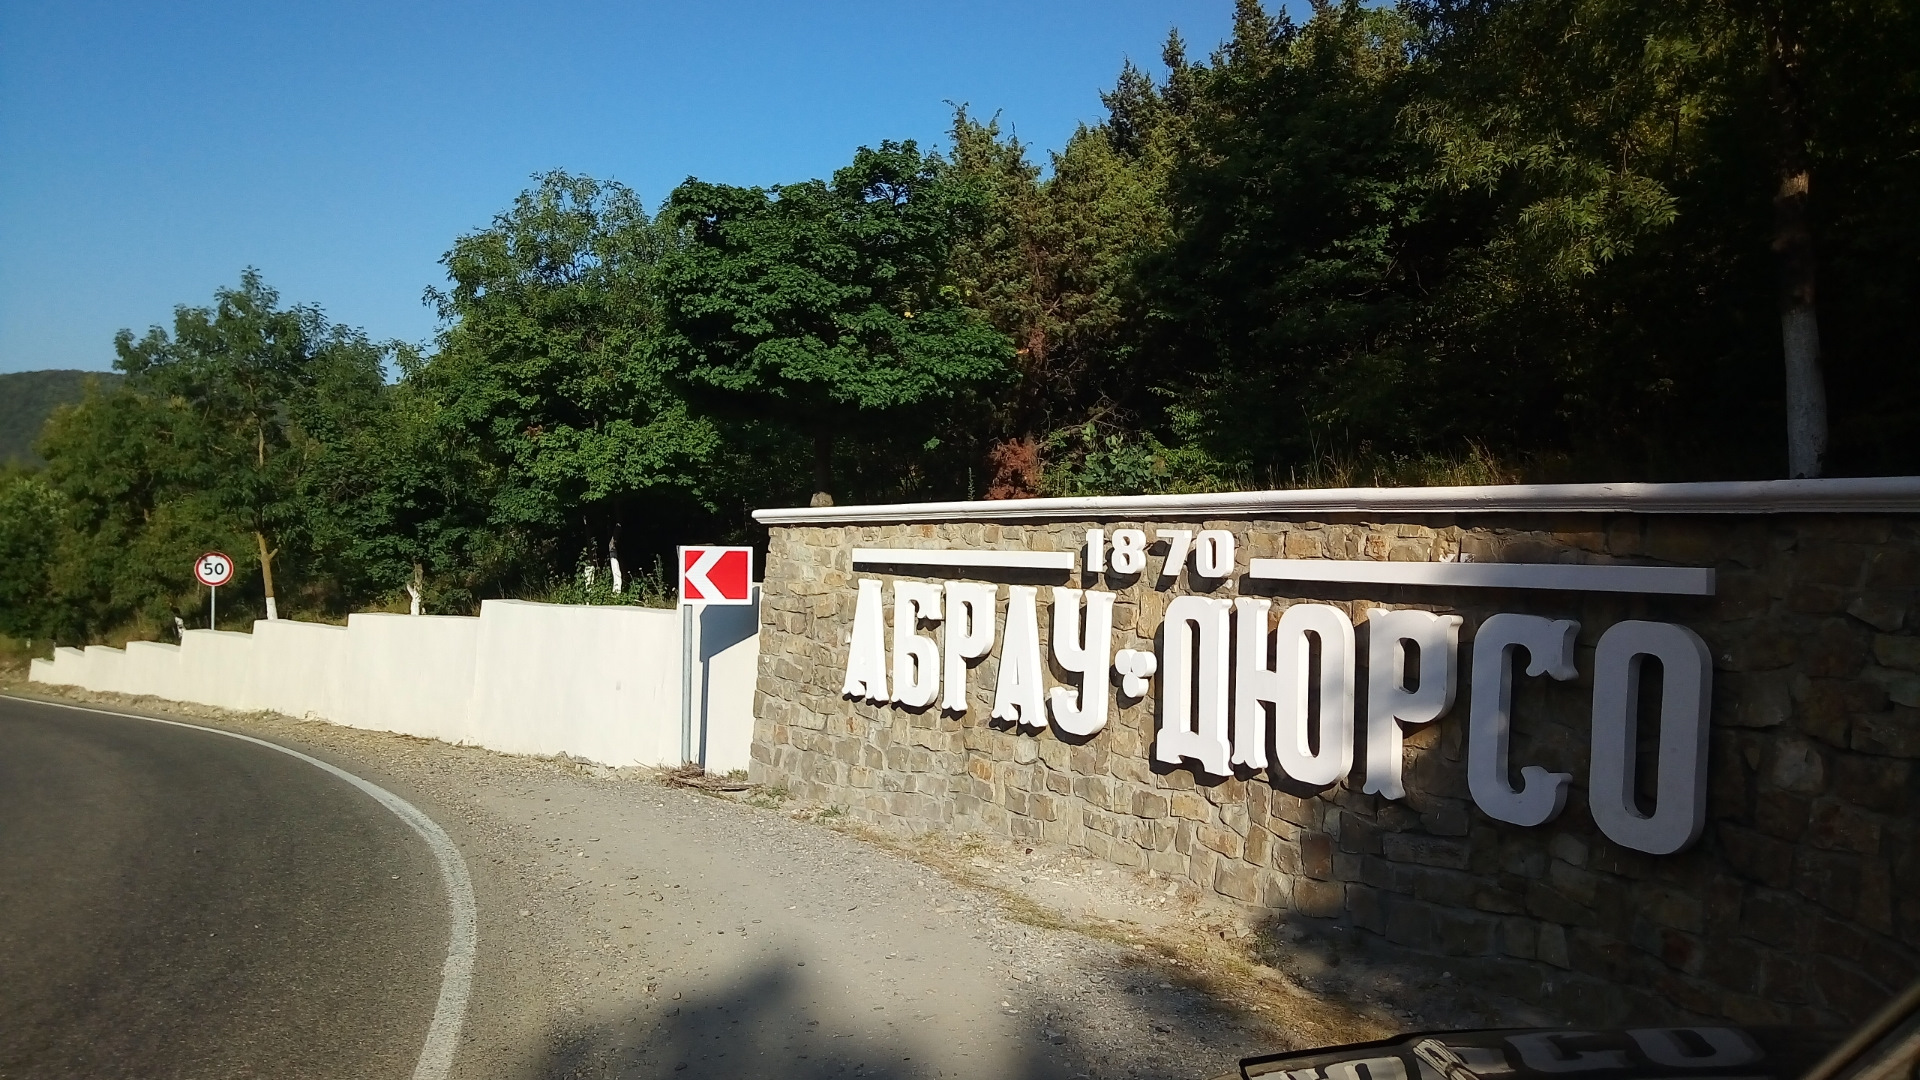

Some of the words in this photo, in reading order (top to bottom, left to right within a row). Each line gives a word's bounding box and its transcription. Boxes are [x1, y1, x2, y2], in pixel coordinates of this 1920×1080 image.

[203, 562, 225, 576] 50
[1085, 528, 1235, 578] 1870
[841, 578, 1117, 736] АБРАУ
[1156, 595, 1714, 856] ДЮРСО
